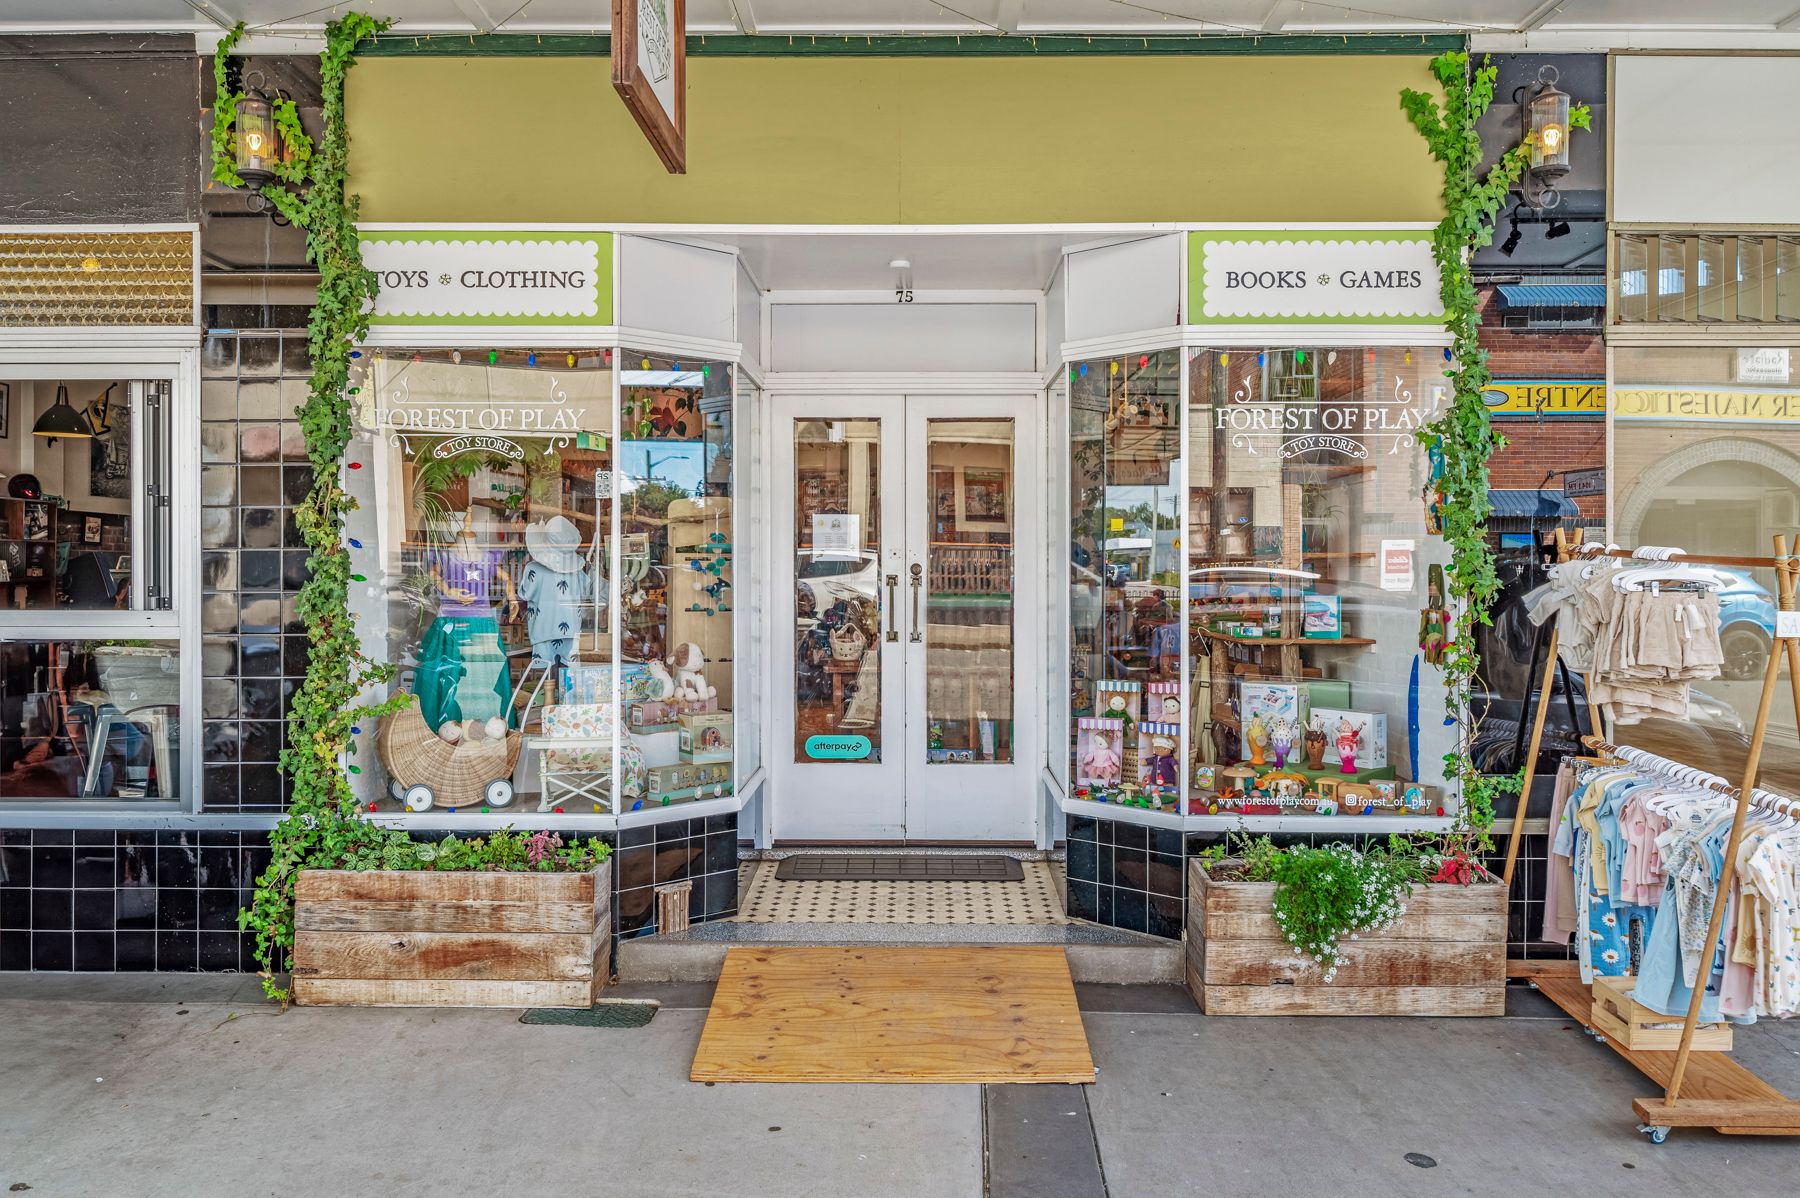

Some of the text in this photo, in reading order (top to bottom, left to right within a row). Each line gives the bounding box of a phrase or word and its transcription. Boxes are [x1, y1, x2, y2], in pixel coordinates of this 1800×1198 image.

[373, 270, 586, 288] TOYS CLOTHING
[1225, 270, 1422, 289] BOOKS GAMES
[895, 290, 914, 303] 75
[374, 408, 586, 430] FOREST OF PLAY
[1215, 407, 1432, 430] FOREST OF PLAY
[447, 436, 511, 453] TOY STORE
[1290, 437, 1355, 453] TOY STORE
[813, 742, 852, 751] afterpay
[1358, 796, 1432, 810] forest_of_play
